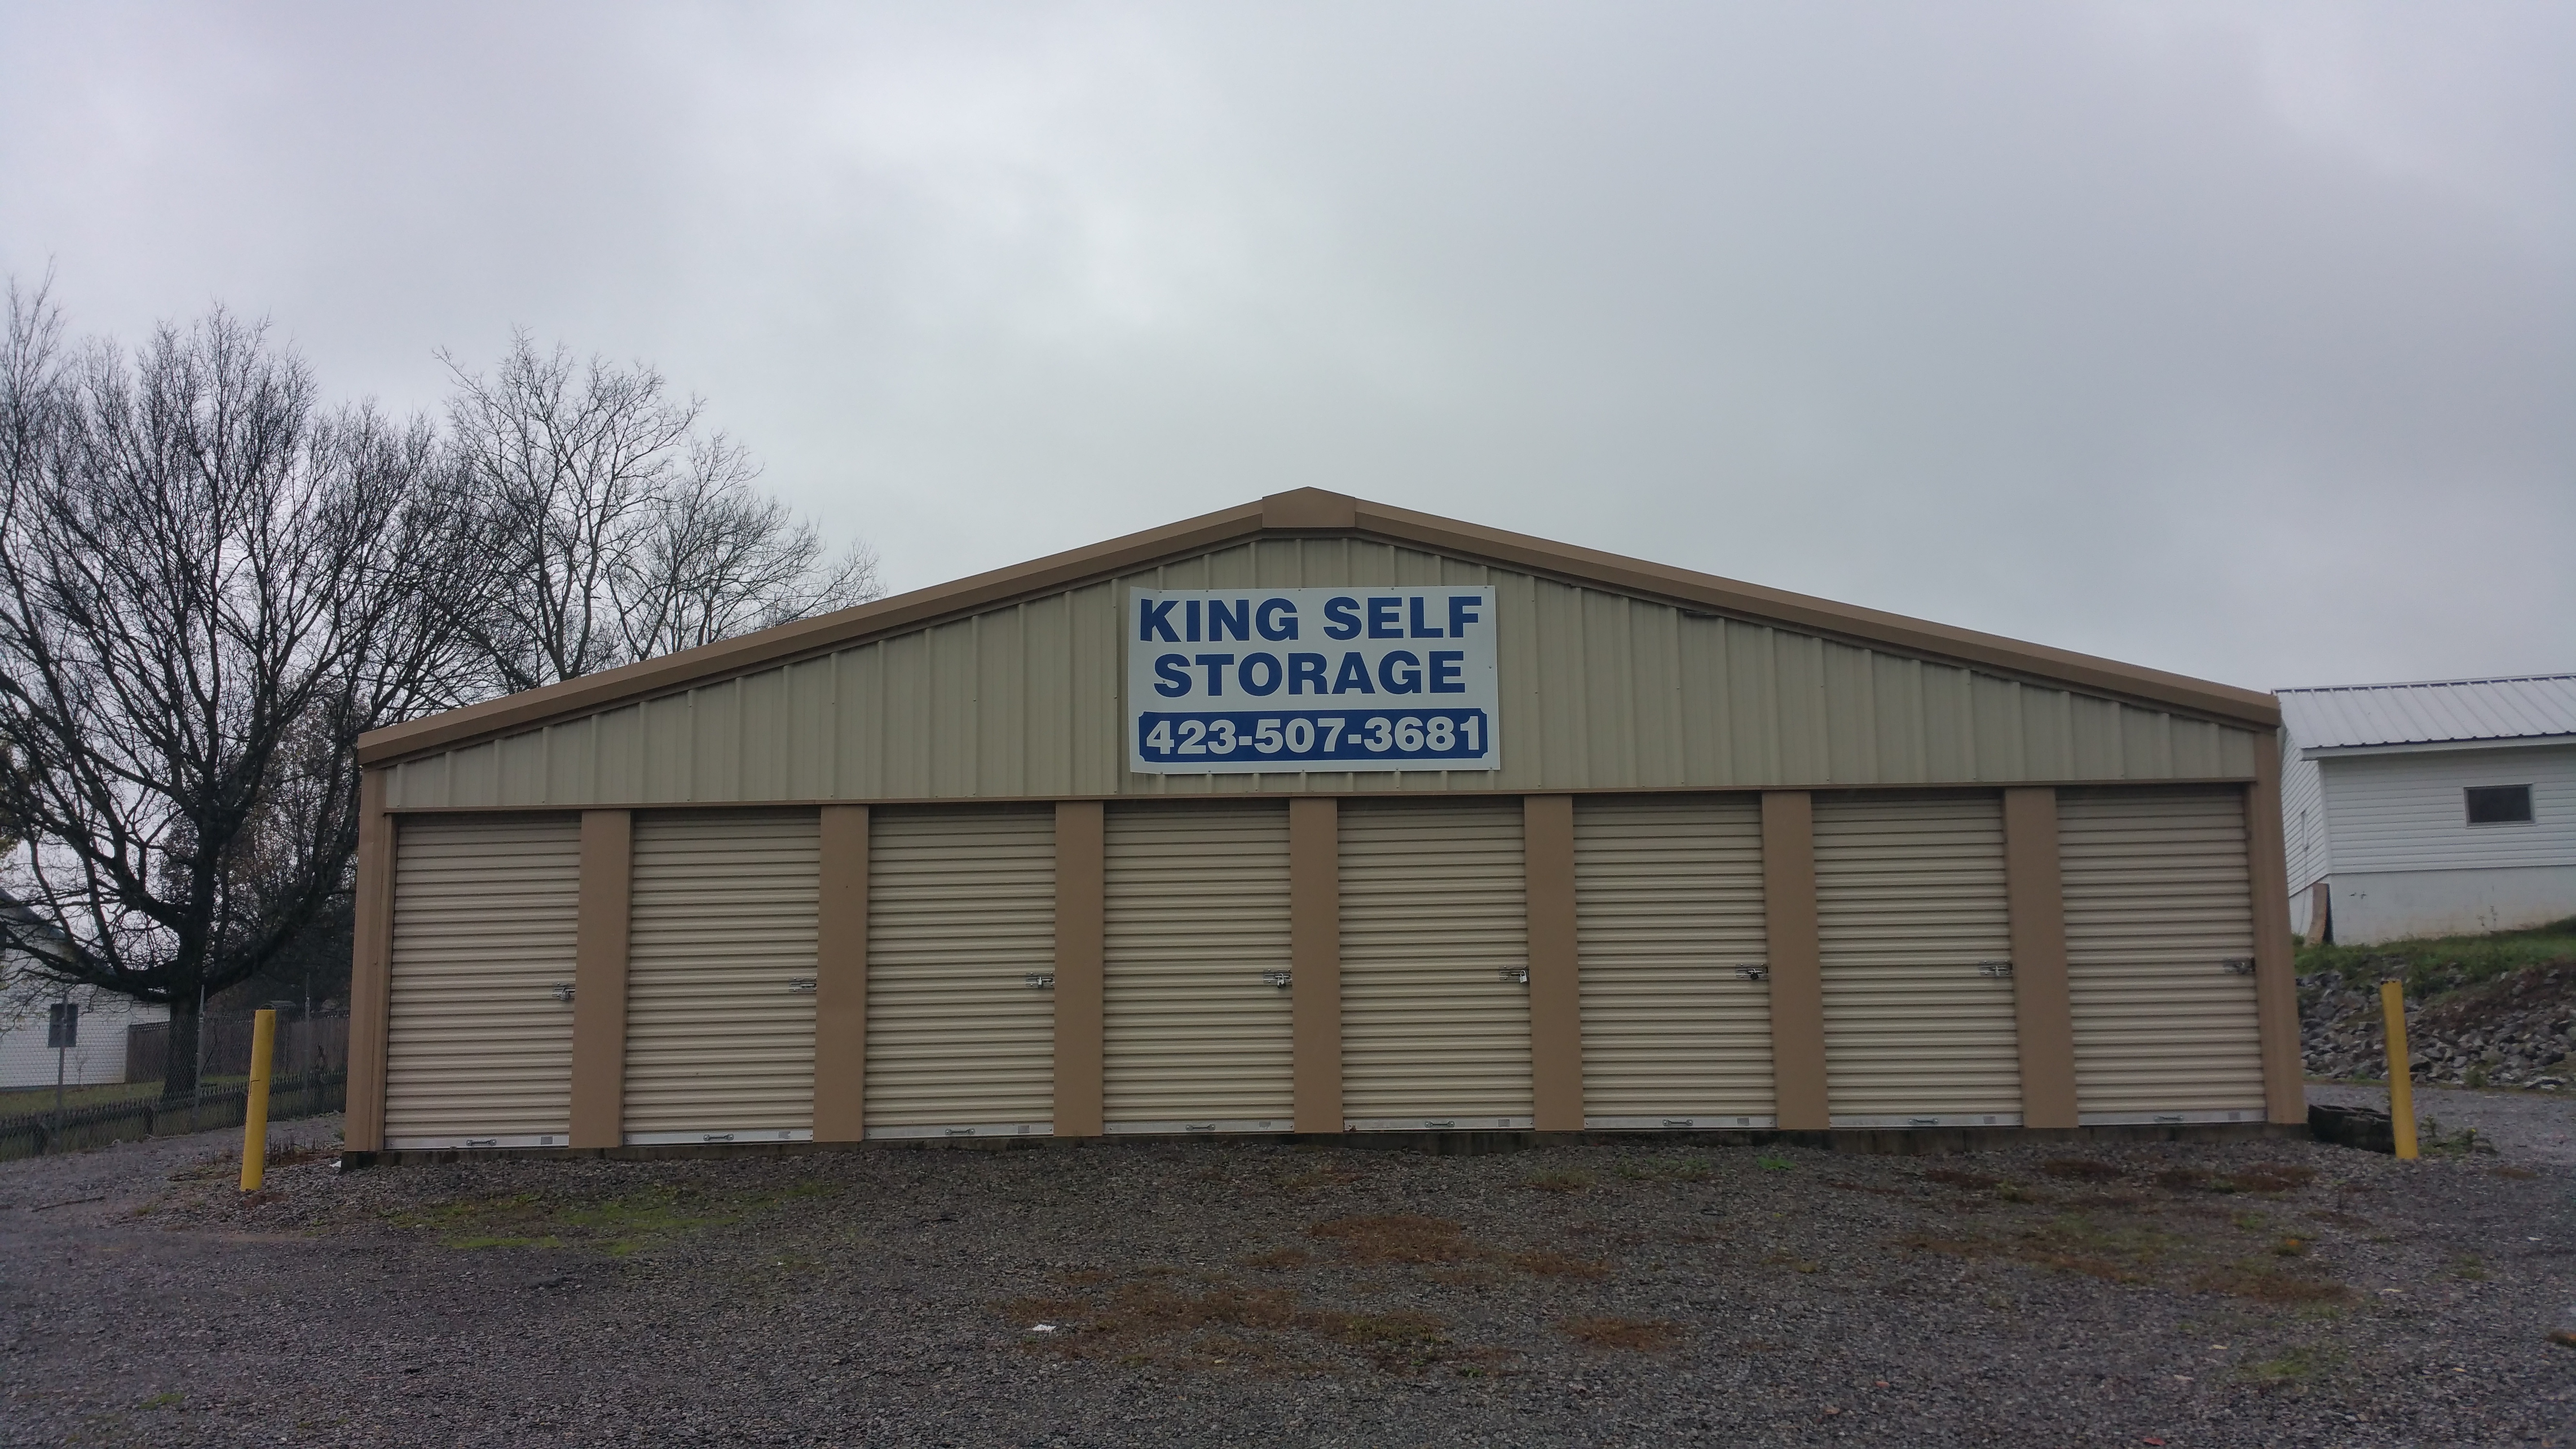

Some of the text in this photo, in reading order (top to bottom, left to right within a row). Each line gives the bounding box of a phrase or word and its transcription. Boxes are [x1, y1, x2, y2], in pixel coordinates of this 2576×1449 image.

[1140, 596, 1482, 643] KING SELF
[1154, 650, 1466, 698] STORAGE
[1146, 716, 1480, 755] 423-507-3681
